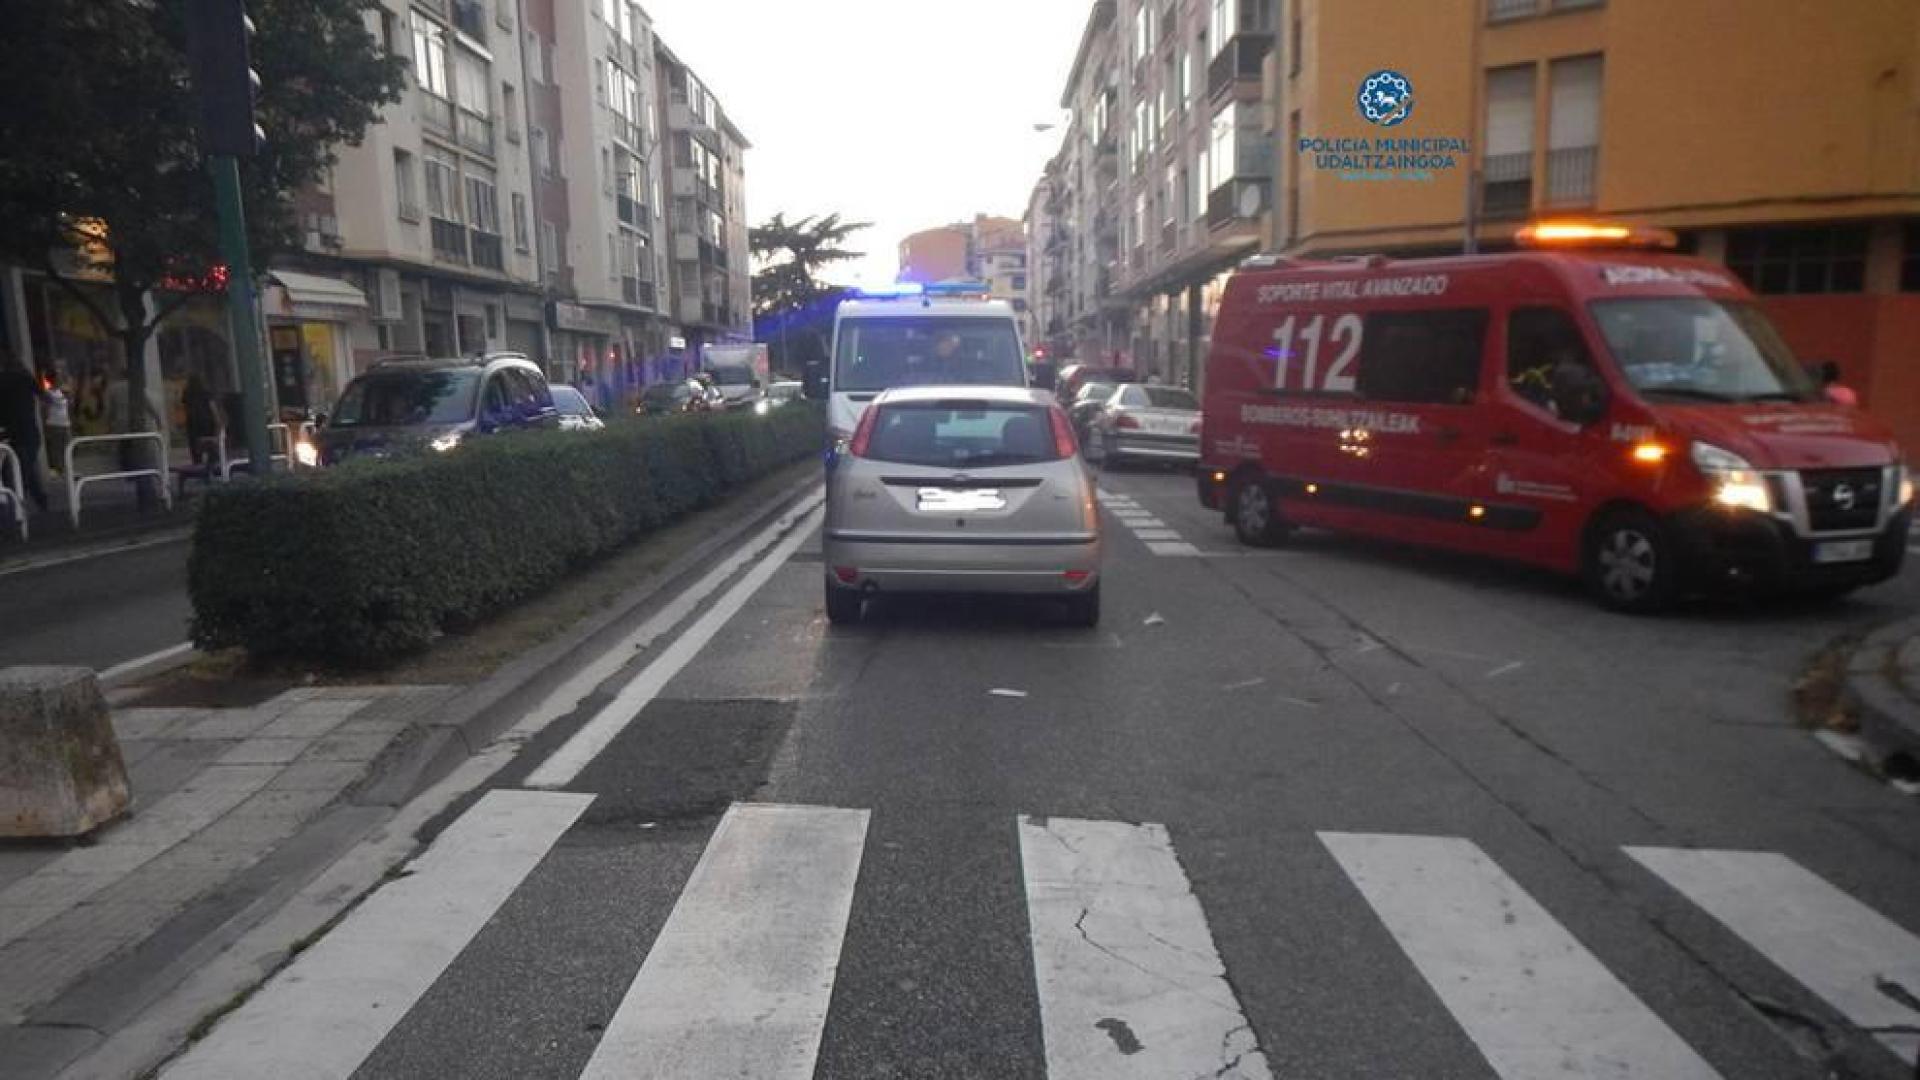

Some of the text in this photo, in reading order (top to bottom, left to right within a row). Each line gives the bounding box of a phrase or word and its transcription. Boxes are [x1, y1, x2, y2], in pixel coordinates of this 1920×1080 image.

[1257, 274, 1448, 303] SOPORTE VITAL AVANZADO
[1271, 312, 1364, 391] 112
